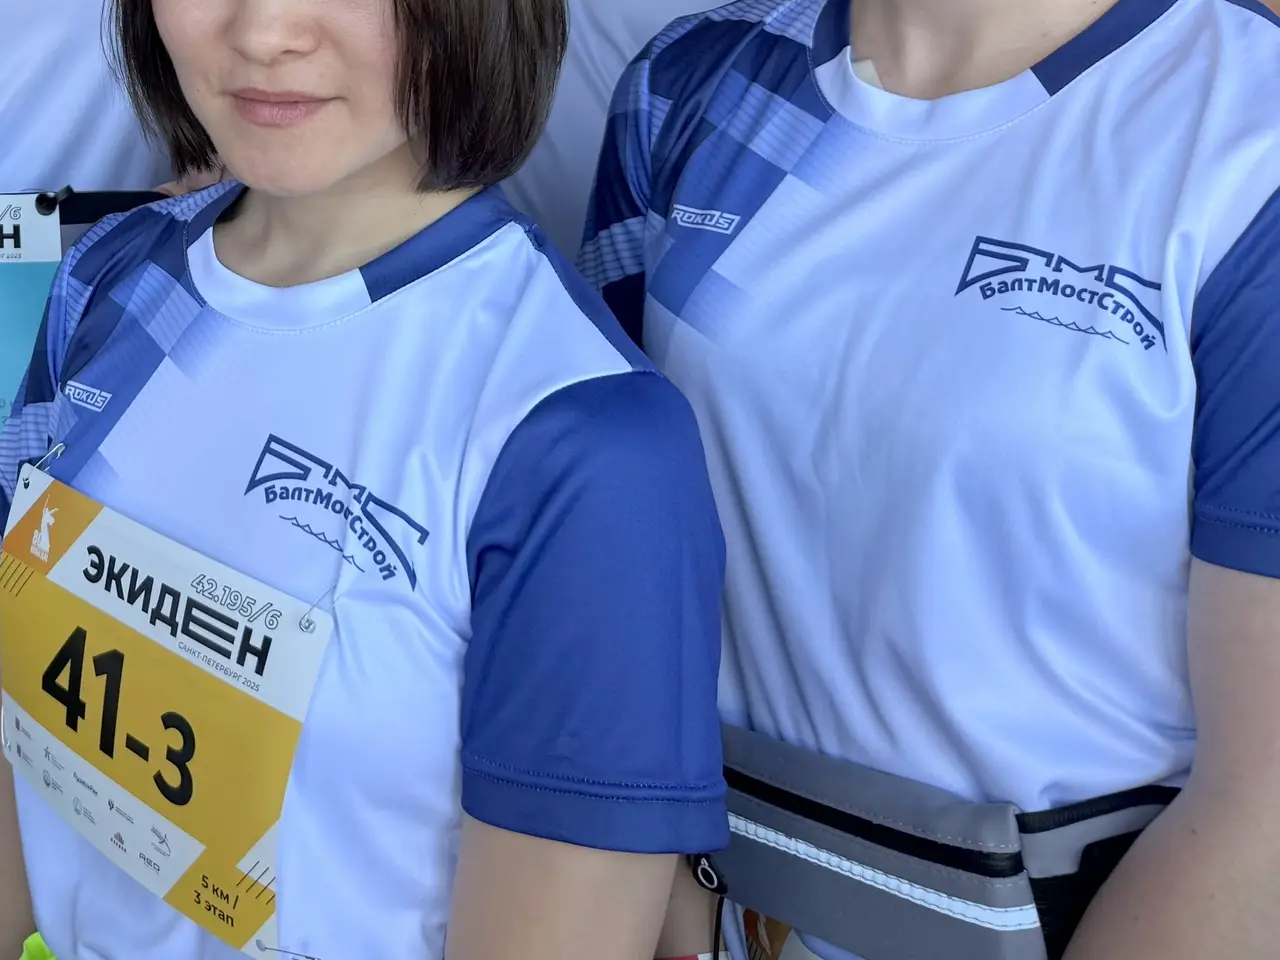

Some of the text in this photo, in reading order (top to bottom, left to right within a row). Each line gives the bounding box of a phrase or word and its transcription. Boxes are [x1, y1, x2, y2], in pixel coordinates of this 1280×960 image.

[671, 203, 741, 235] ROKUS
[979, 276, 1157, 351] БалтМостСтрой
[65, 380, 113, 412] ROKUS
[82, 544, 274, 677] ЭКИДЕН
[190, 573, 283, 630] 42.195/6
[177, 641, 261, 693] САНКТ-ПЕТЕРБУРГ 2025
[40, 625, 197, 807] 41-3
[193, 889, 235, 927] 3 этап
[201, 874, 209, 889] 5
[211, 883, 230, 904] км
